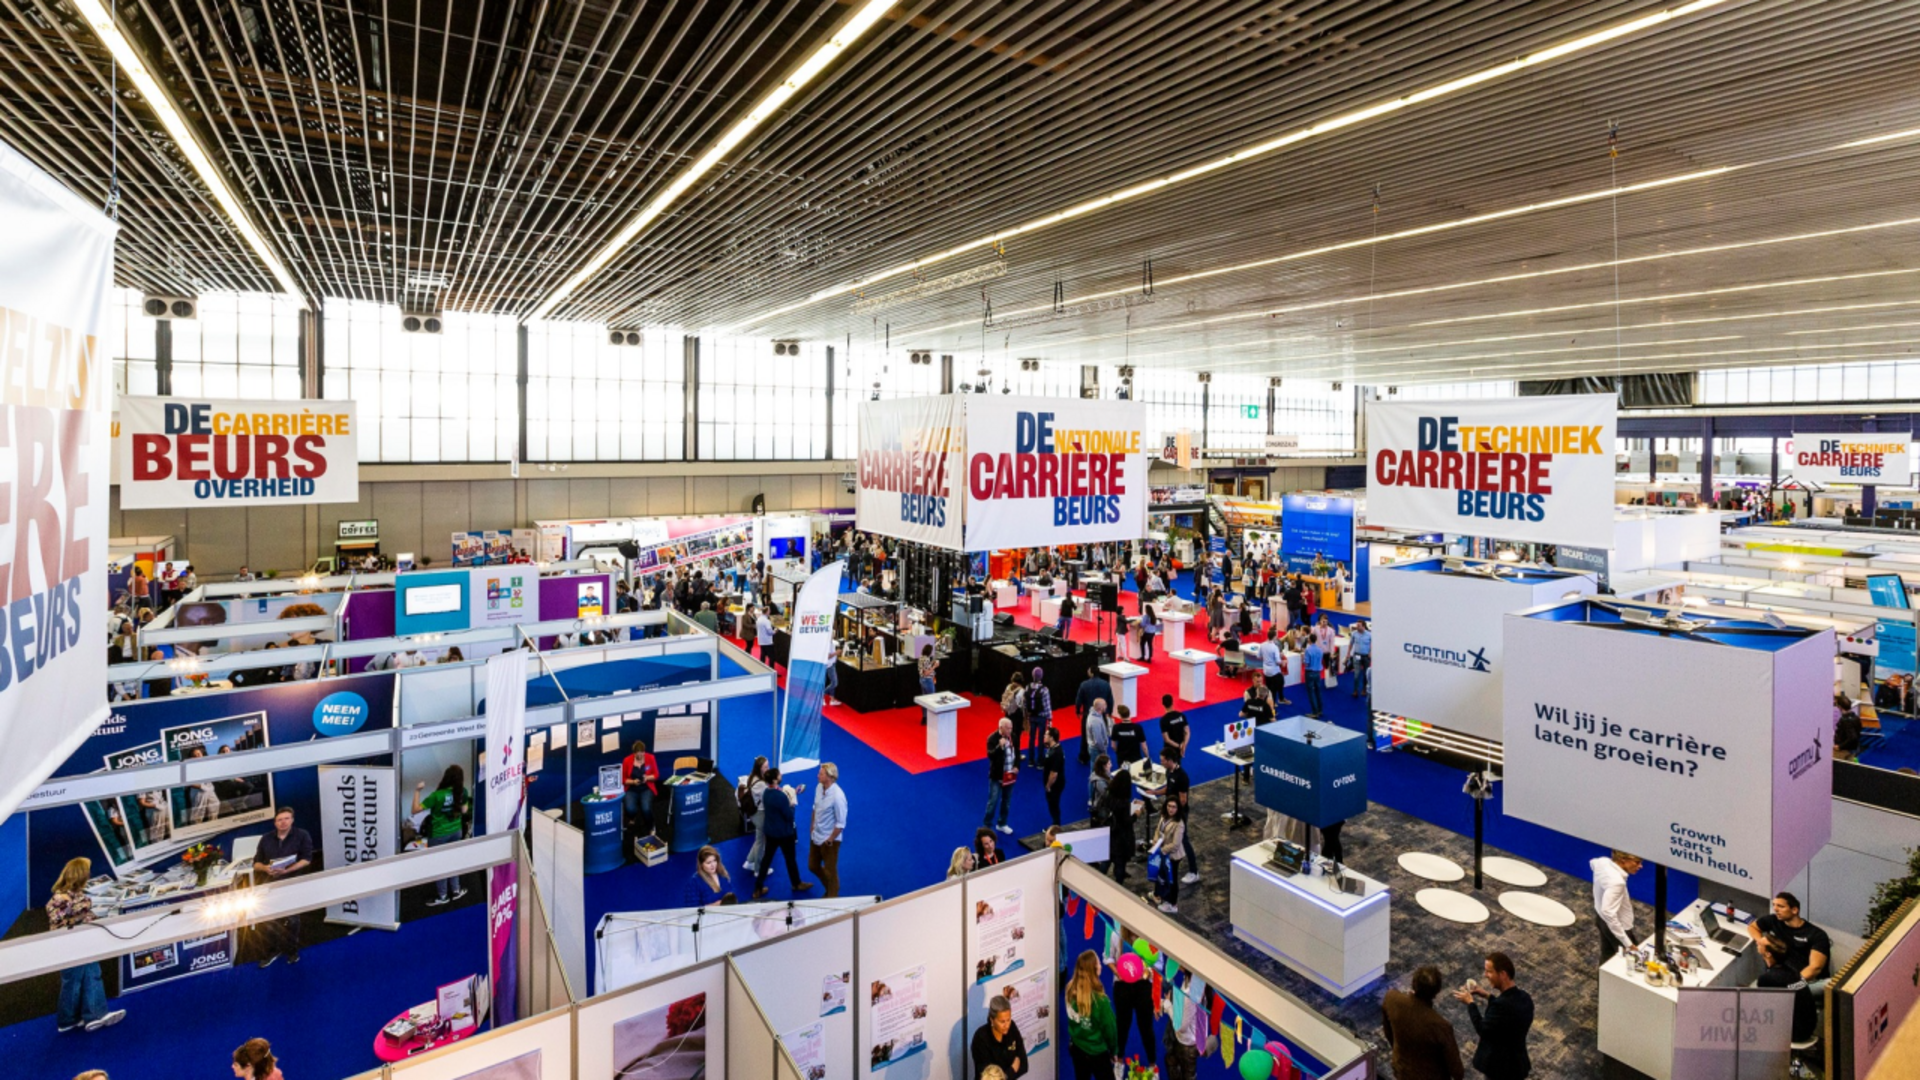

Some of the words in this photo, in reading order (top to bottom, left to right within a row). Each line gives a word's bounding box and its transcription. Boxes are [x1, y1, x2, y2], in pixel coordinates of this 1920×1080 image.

[164, 403, 212, 434] DE
[212, 409, 350, 435] CARRIÈRE
[1016, 411, 1055, 454] DE
[1055, 430, 1141, 455] NATIONALE
[1418, 416, 1459, 452] DE
[1457, 425, 1604, 455] TECHNIEK
[1820, 439, 1841, 453] DE
[132, 433, 327, 481] BEURS
[970, 442, 1126, 501] CARRIÈRE
[1375, 441, 1553, 494] CARRIÈRE
[1840, 466, 1881, 477] BEURS
[194, 477, 315, 499] OVERHEID
[901, 492, 946, 528] BEURS
[1054, 494, 1120, 526] BEURS
[1457, 488, 1545, 522] BEURS
[341, 526, 377, 536] COFFEE
[321, 715, 355, 726] MEE!
[322, 704, 361, 715] NEEM
[170, 727, 214, 745] JONG
[1535, 702, 1569, 725] Wil
[1573, 711, 1595, 735] jij
[1601, 717, 1622, 738] je
[1629, 727, 1728, 760] carrière
[116, 748, 159, 769] JONG
[1535, 723, 1588, 751] laten
[1594, 742, 1698, 777] groeien?
[1670, 822, 1726, 848] Growth
[1670, 836, 1713, 855] starts
[1670, 847, 1704, 865] with
[1708, 856, 1753, 880] hello.
[190, 951, 225, 968] JONG
